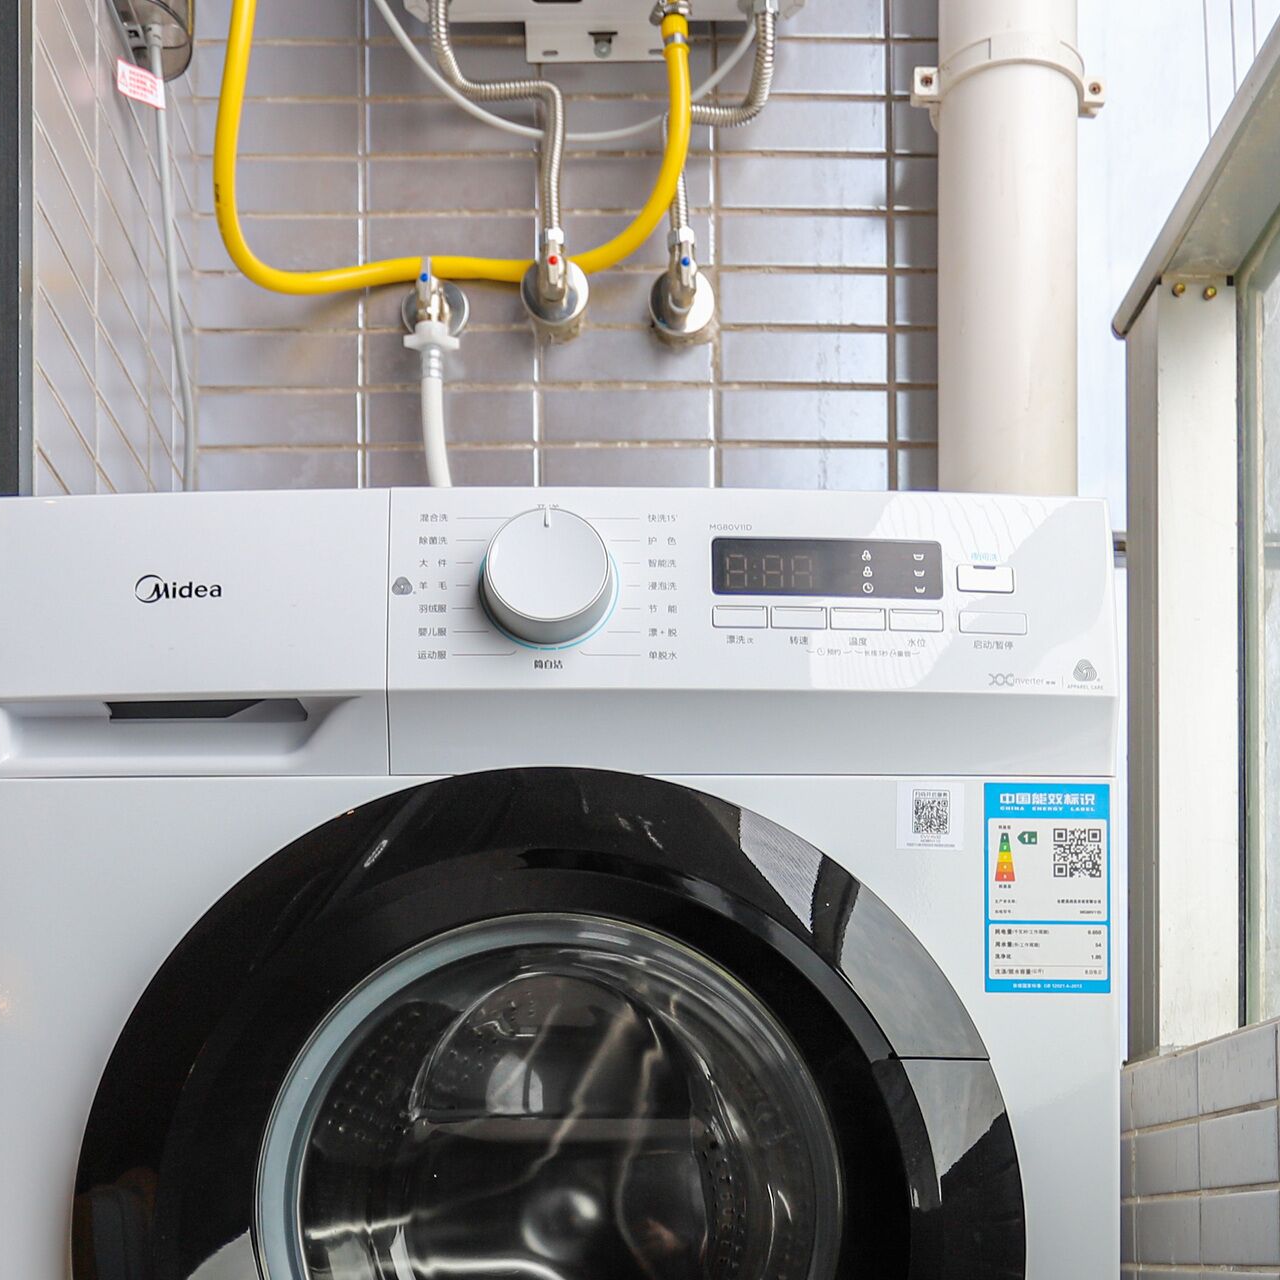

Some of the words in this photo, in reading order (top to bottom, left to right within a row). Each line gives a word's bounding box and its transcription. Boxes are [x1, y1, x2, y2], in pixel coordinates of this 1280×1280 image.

[419, 513, 448, 522] 混合洗
[418, 536, 448, 545] 除菌洗
[648, 559, 677, 568] 智能洗
[137, 577, 222, 601] Midea
[418, 604, 447, 613] 羽绒服
[418, 627, 447, 637] 婴儿服
[789, 636, 808, 646] 转速
[848, 637, 867, 646] 温度
[906, 639, 925, 648] 水位
[973, 640, 1014, 650] 启动/暂停
[418, 650, 447, 660] 运动服
[648, 651, 677, 660] 单脱水
[999, 793, 1095, 806] 中国能效标识
